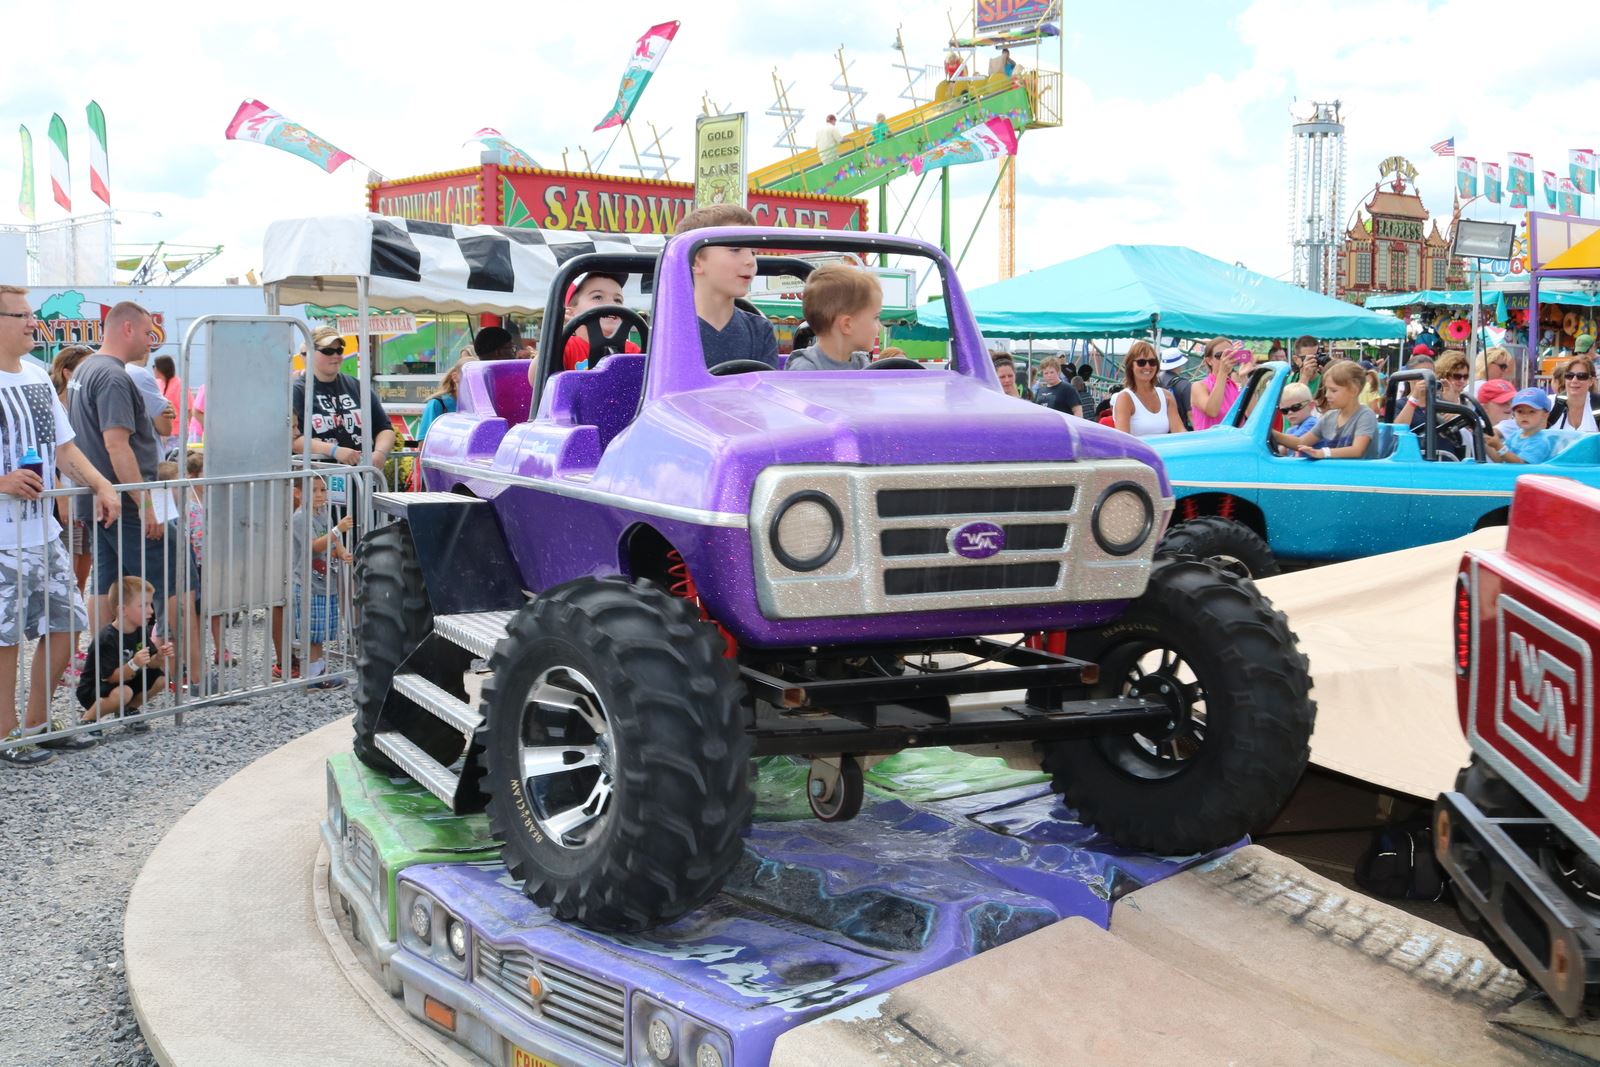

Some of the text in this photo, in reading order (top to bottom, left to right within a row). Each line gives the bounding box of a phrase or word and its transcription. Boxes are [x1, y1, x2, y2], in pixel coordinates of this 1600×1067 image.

[707, 130, 735, 142] GOLD
[701, 145, 740, 160] ACCESS
[699, 162, 740, 178] LANE
[379, 185, 481, 226] SANDWICH CAFE
[1378, 220, 1421, 240] EXPRESS
[510, 779, 543, 843] BEAR CLAW
